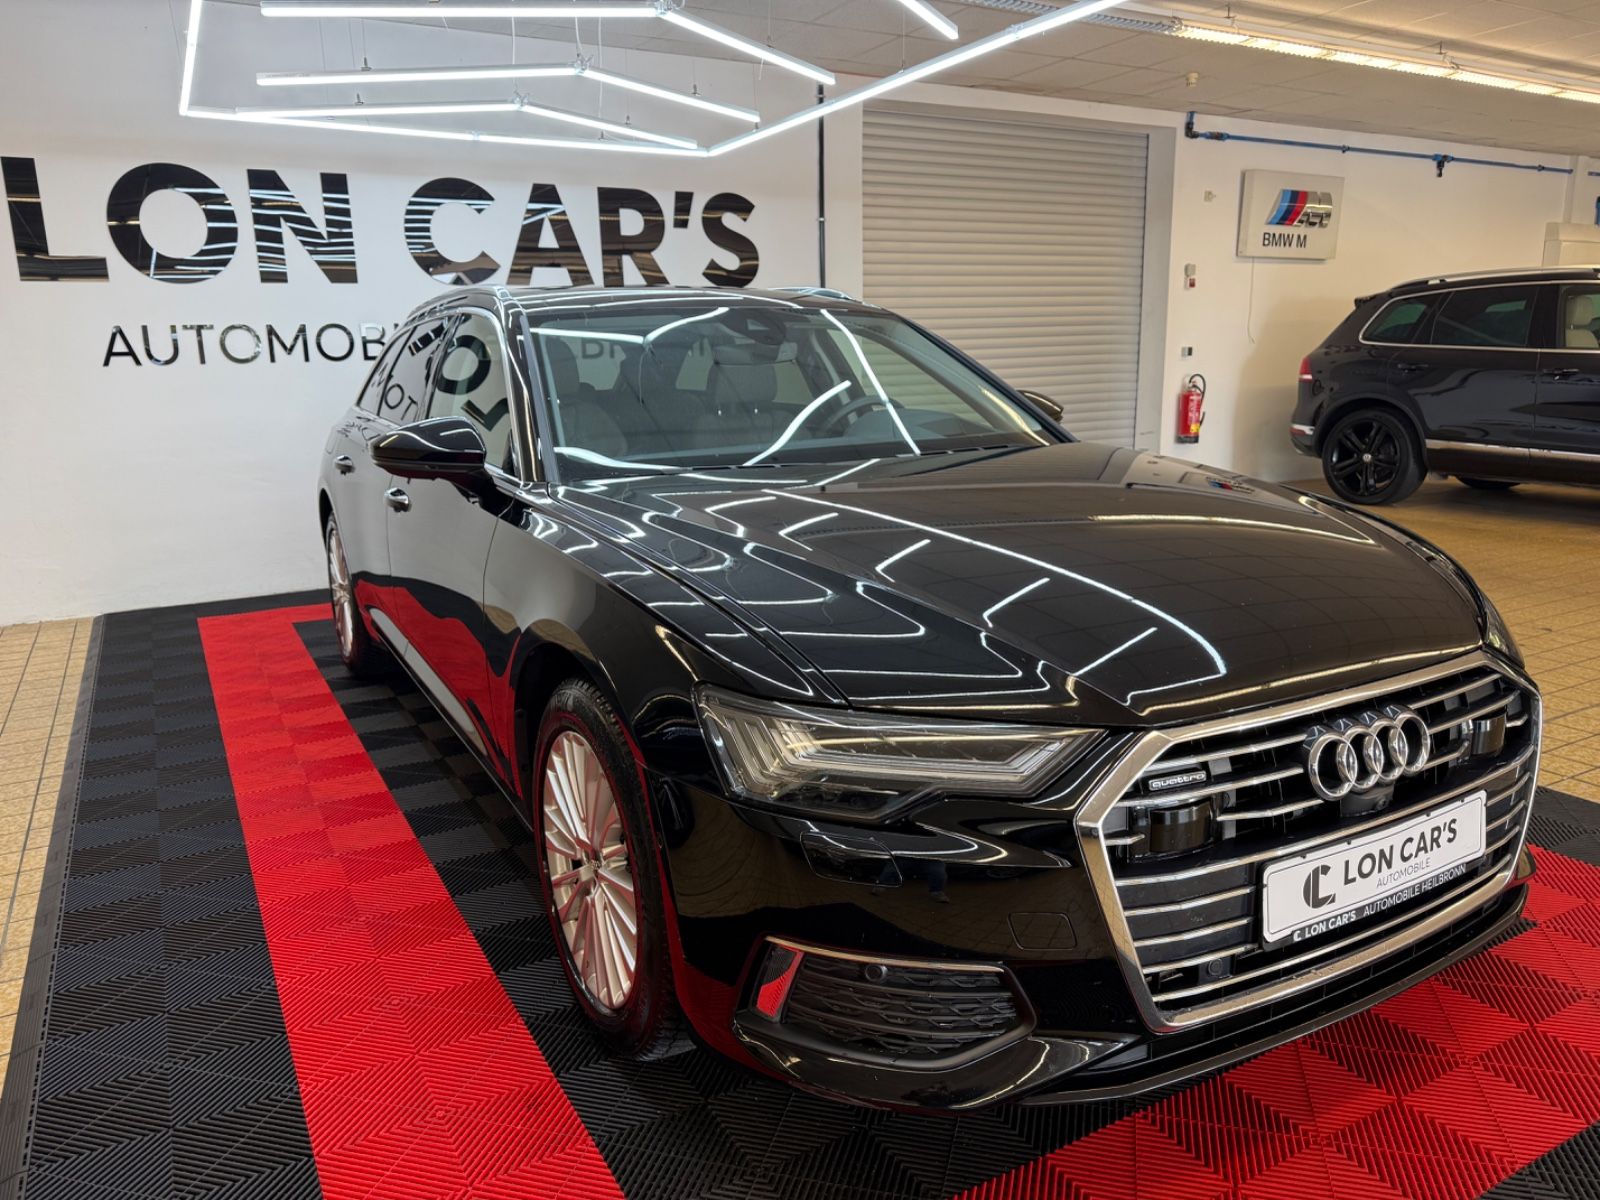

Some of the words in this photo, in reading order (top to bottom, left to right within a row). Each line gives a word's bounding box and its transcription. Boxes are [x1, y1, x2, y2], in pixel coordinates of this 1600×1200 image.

[1, 156, 358, 284] LON
[404, 177, 761, 287] CAR'S
[1262, 232, 1294, 248] BMW
[1296, 234, 1308, 249] M
[103, 321, 400, 368] AUTOMOB
[1152, 773, 1205, 788] quattro
[1343, 844, 1394, 886] LON
[1400, 818, 1458, 863] CAR'S
[1376, 857, 1431, 888] AUTOMOBILE
[1305, 921, 1327, 938] LON
[1328, 910, 1357, 929] CAR'S
[1363, 884, 1421, 917] AUTOMOBILE
[1421, 863, 1467, 893] HEILBRONN
